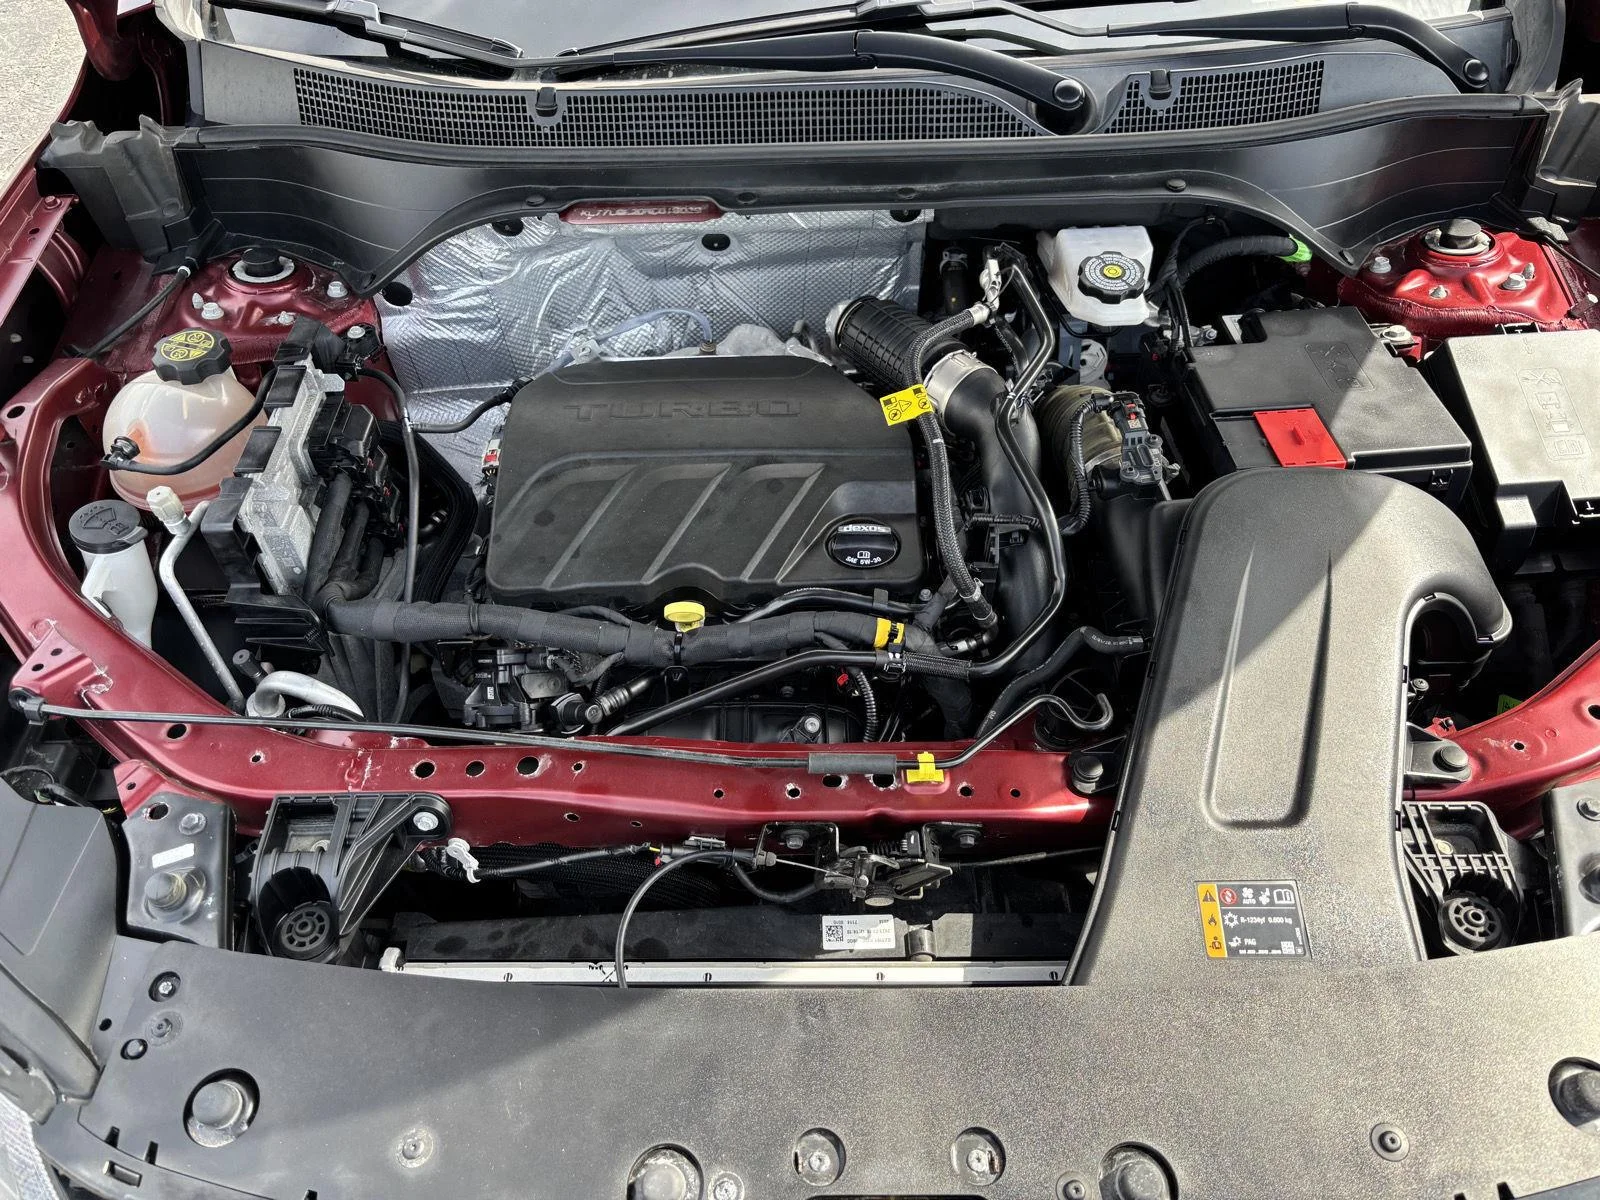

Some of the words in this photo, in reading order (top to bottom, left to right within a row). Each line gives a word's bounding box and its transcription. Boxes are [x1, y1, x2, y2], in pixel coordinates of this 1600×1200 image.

[563, 400, 803, 421] TURBO
[843, 523, 889, 533] dexos
[845, 555, 858, 564] SAE
[860, 556, 882, 565] 5W-30
[1244, 938, 1257, 946] PAG
